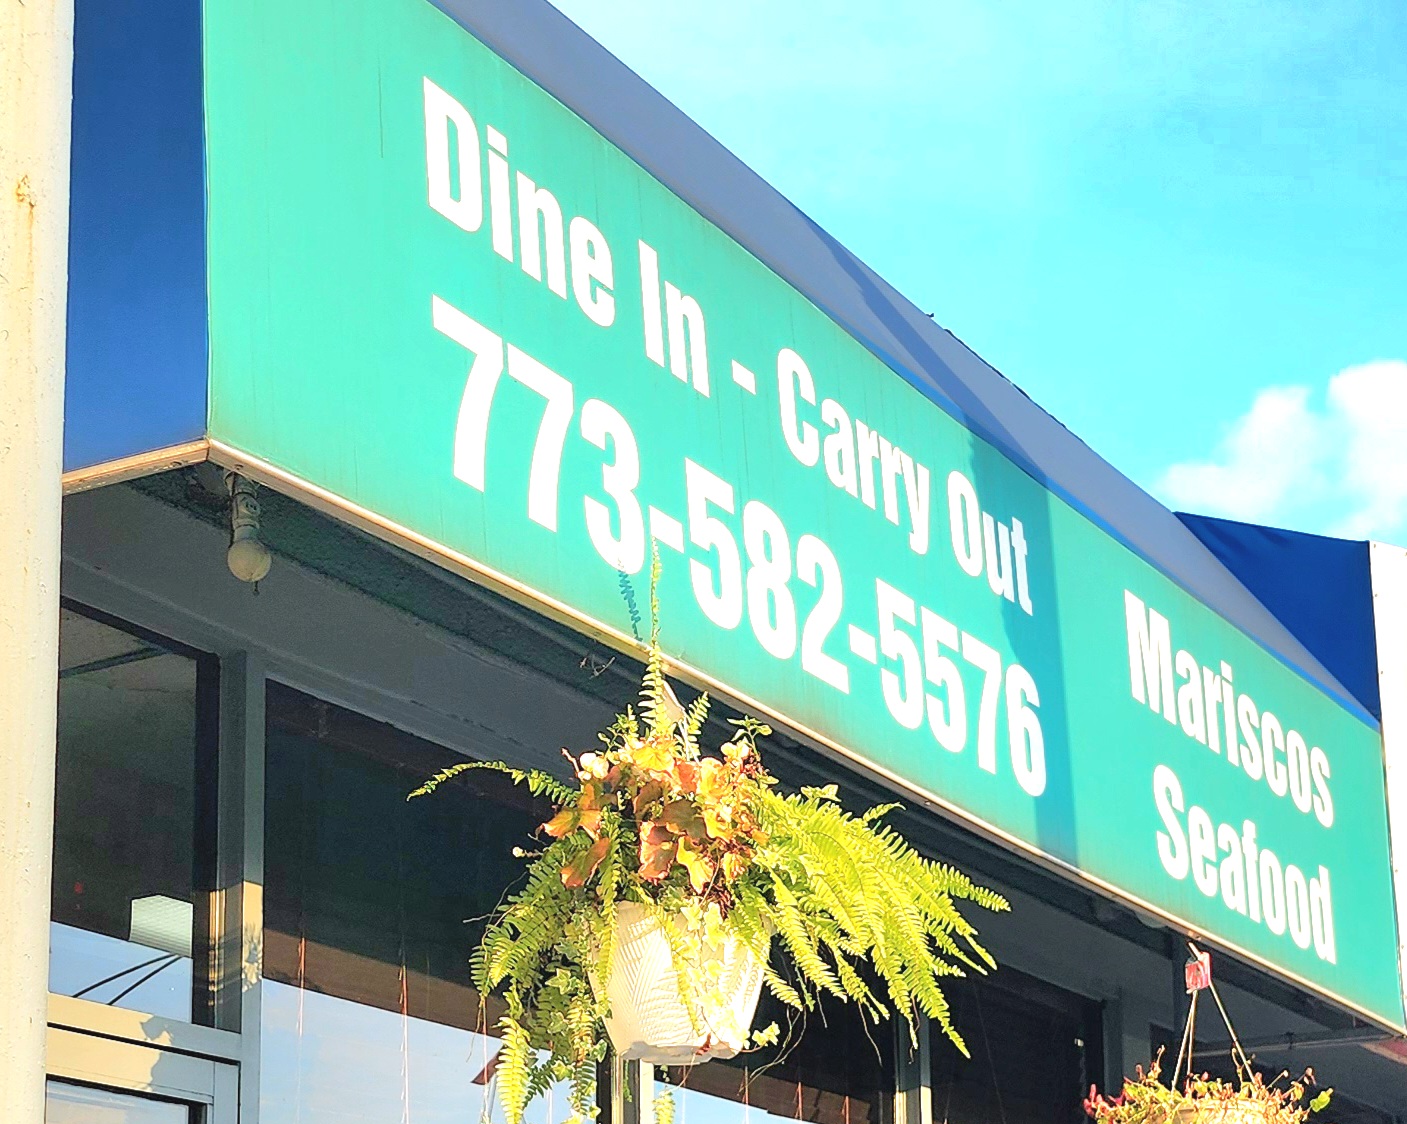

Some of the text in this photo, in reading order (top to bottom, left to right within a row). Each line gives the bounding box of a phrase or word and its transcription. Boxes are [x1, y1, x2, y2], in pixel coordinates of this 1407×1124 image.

[423, 75, 616, 328] Dine
[638, 238, 711, 398] In
[776, 347, 930, 555] Carry
[947, 469, 1034, 617] Out
[432, 293, 1047, 798] 773-582-5576
[1124, 588, 1334, 828] Mariscos
[1153, 763, 1337, 966] Seafood
